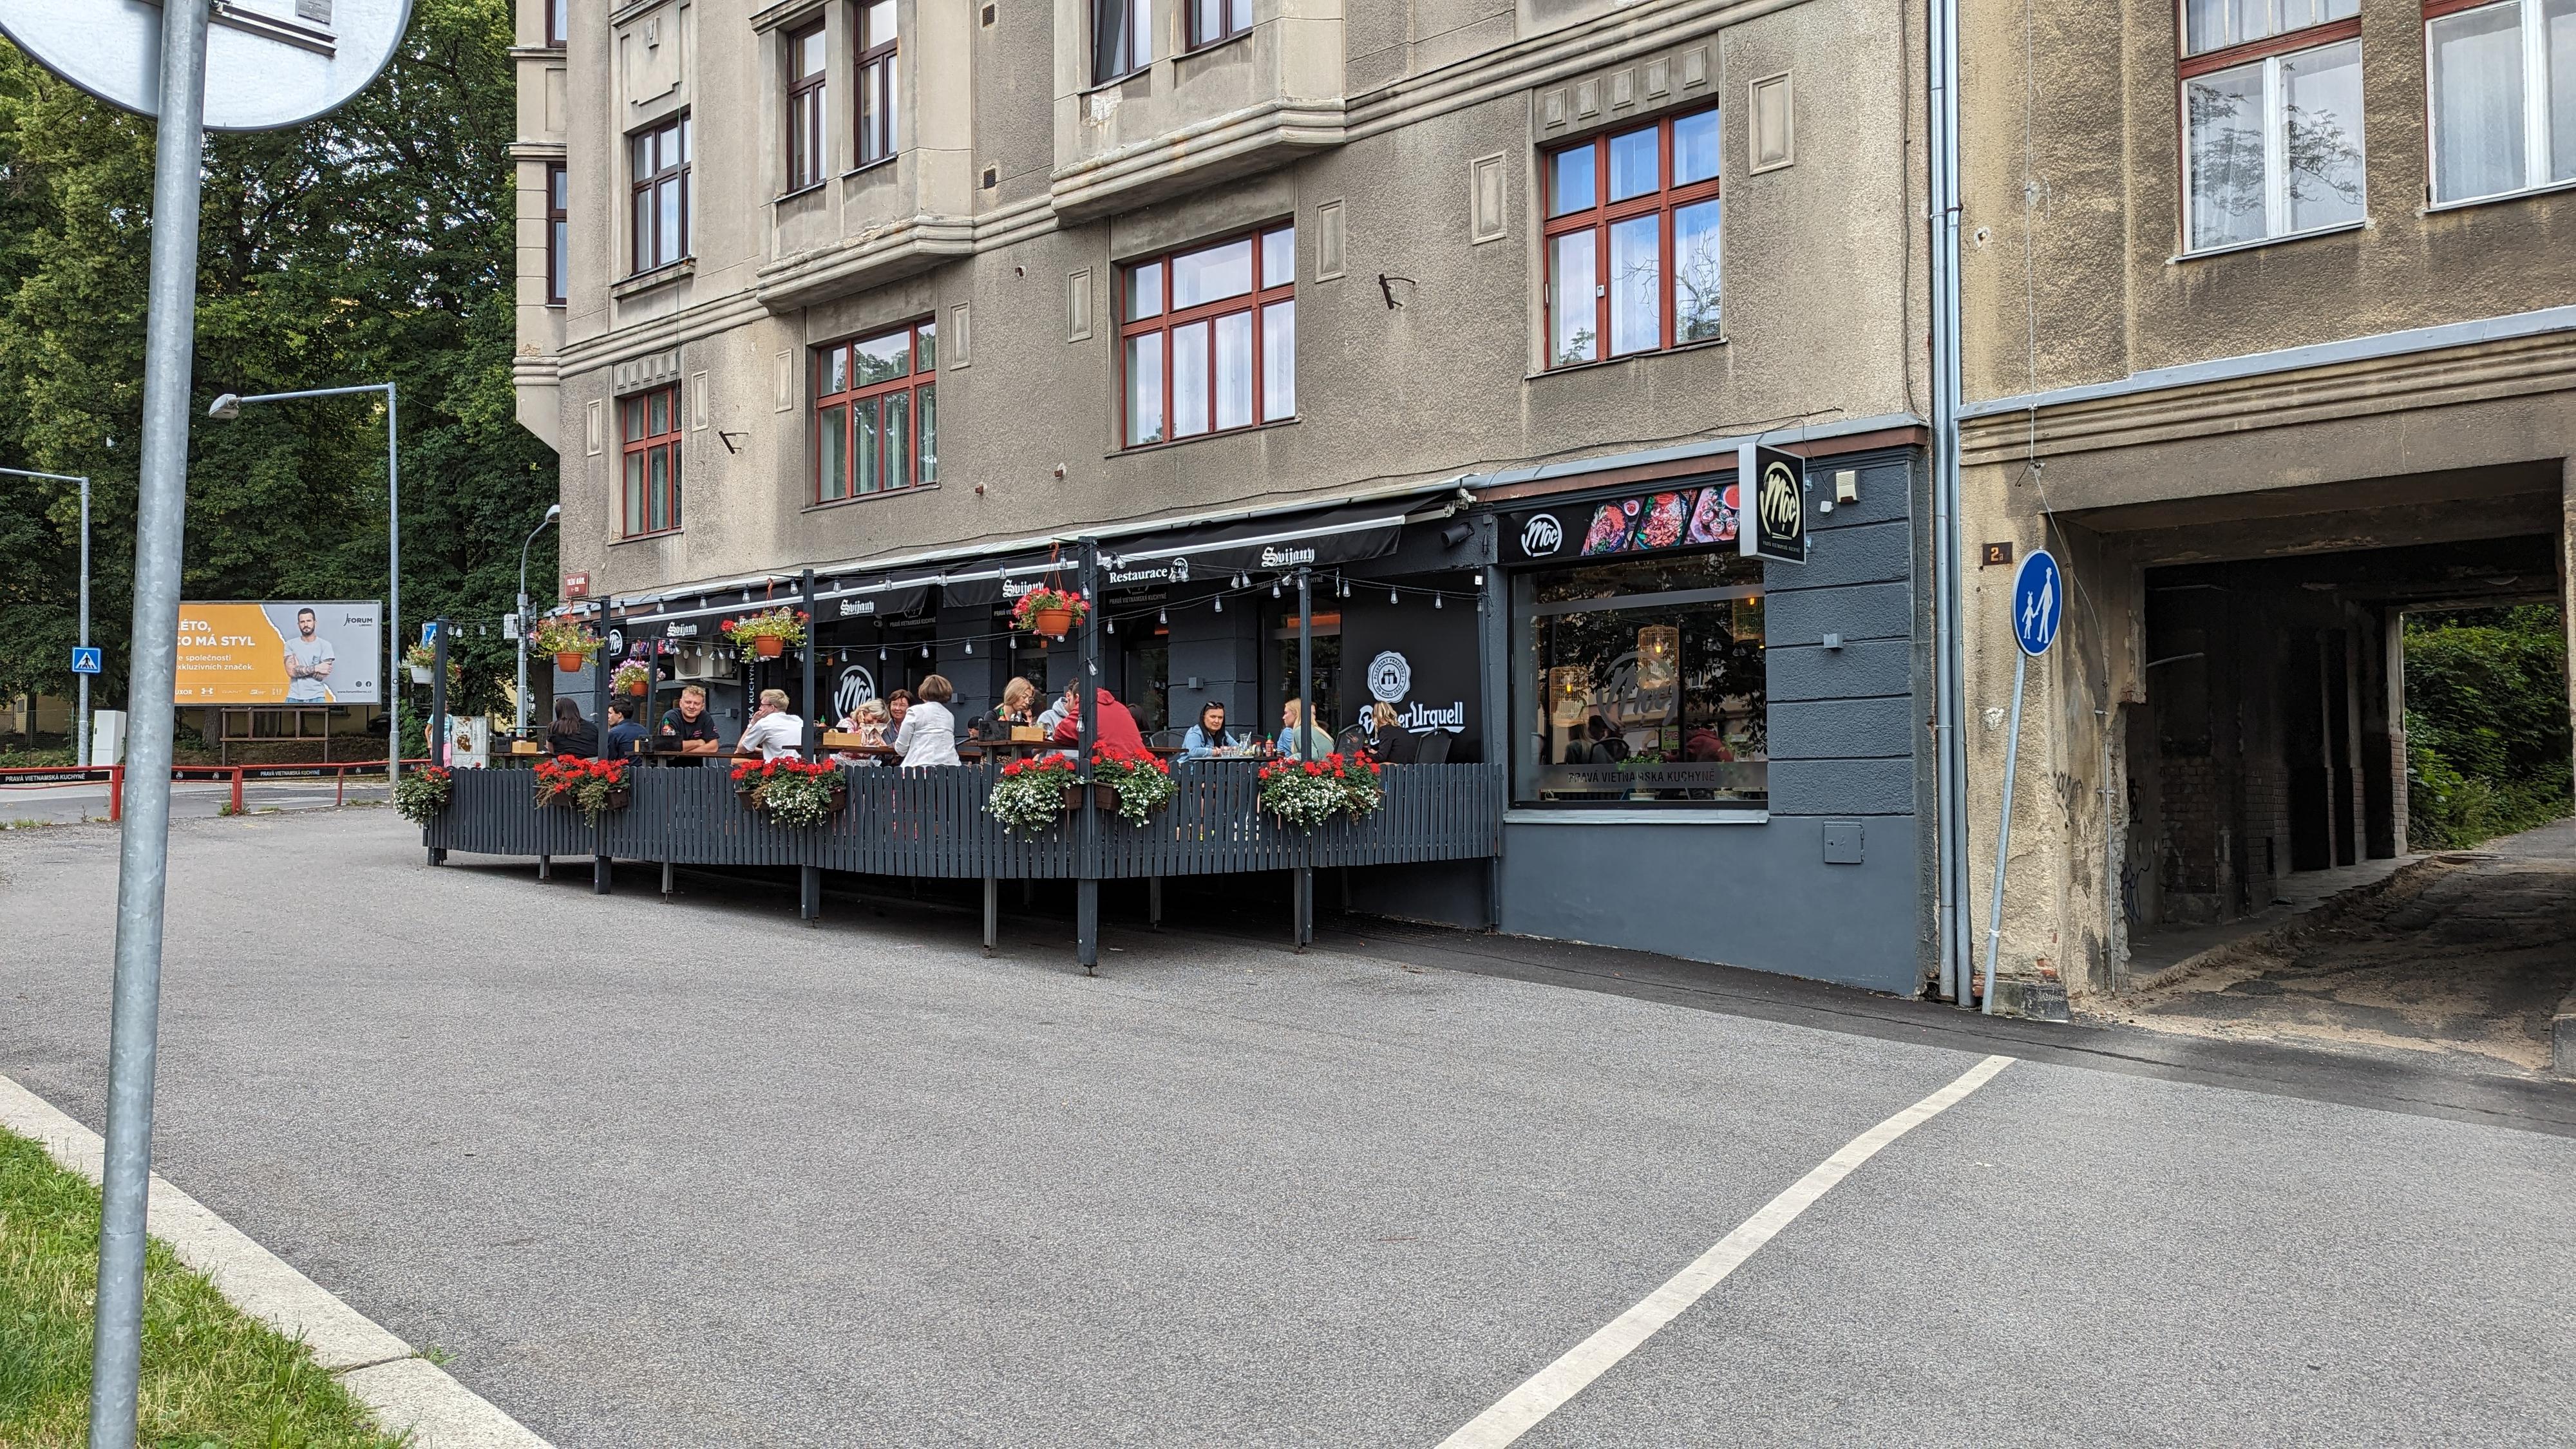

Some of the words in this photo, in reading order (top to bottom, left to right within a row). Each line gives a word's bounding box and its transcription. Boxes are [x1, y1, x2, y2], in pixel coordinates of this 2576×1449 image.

[1261, 546, 1314, 567] Svijany
[1109, 568, 1168, 583] Restaurace
[840, 598, 875, 616] Svijany
[178, 619, 211, 632] ÉTO,
[667, 621, 697, 637] Svijany
[195, 634, 217, 647] MÁ
[221, 636, 256, 647] STYL
[185, 654, 231, 663] společnosti
[1410, 701, 1464, 732] Urquell
[1569, 770, 1599, 782] PRAVÁ
[1667, 768, 1715, 782] KUCHYNĚ
